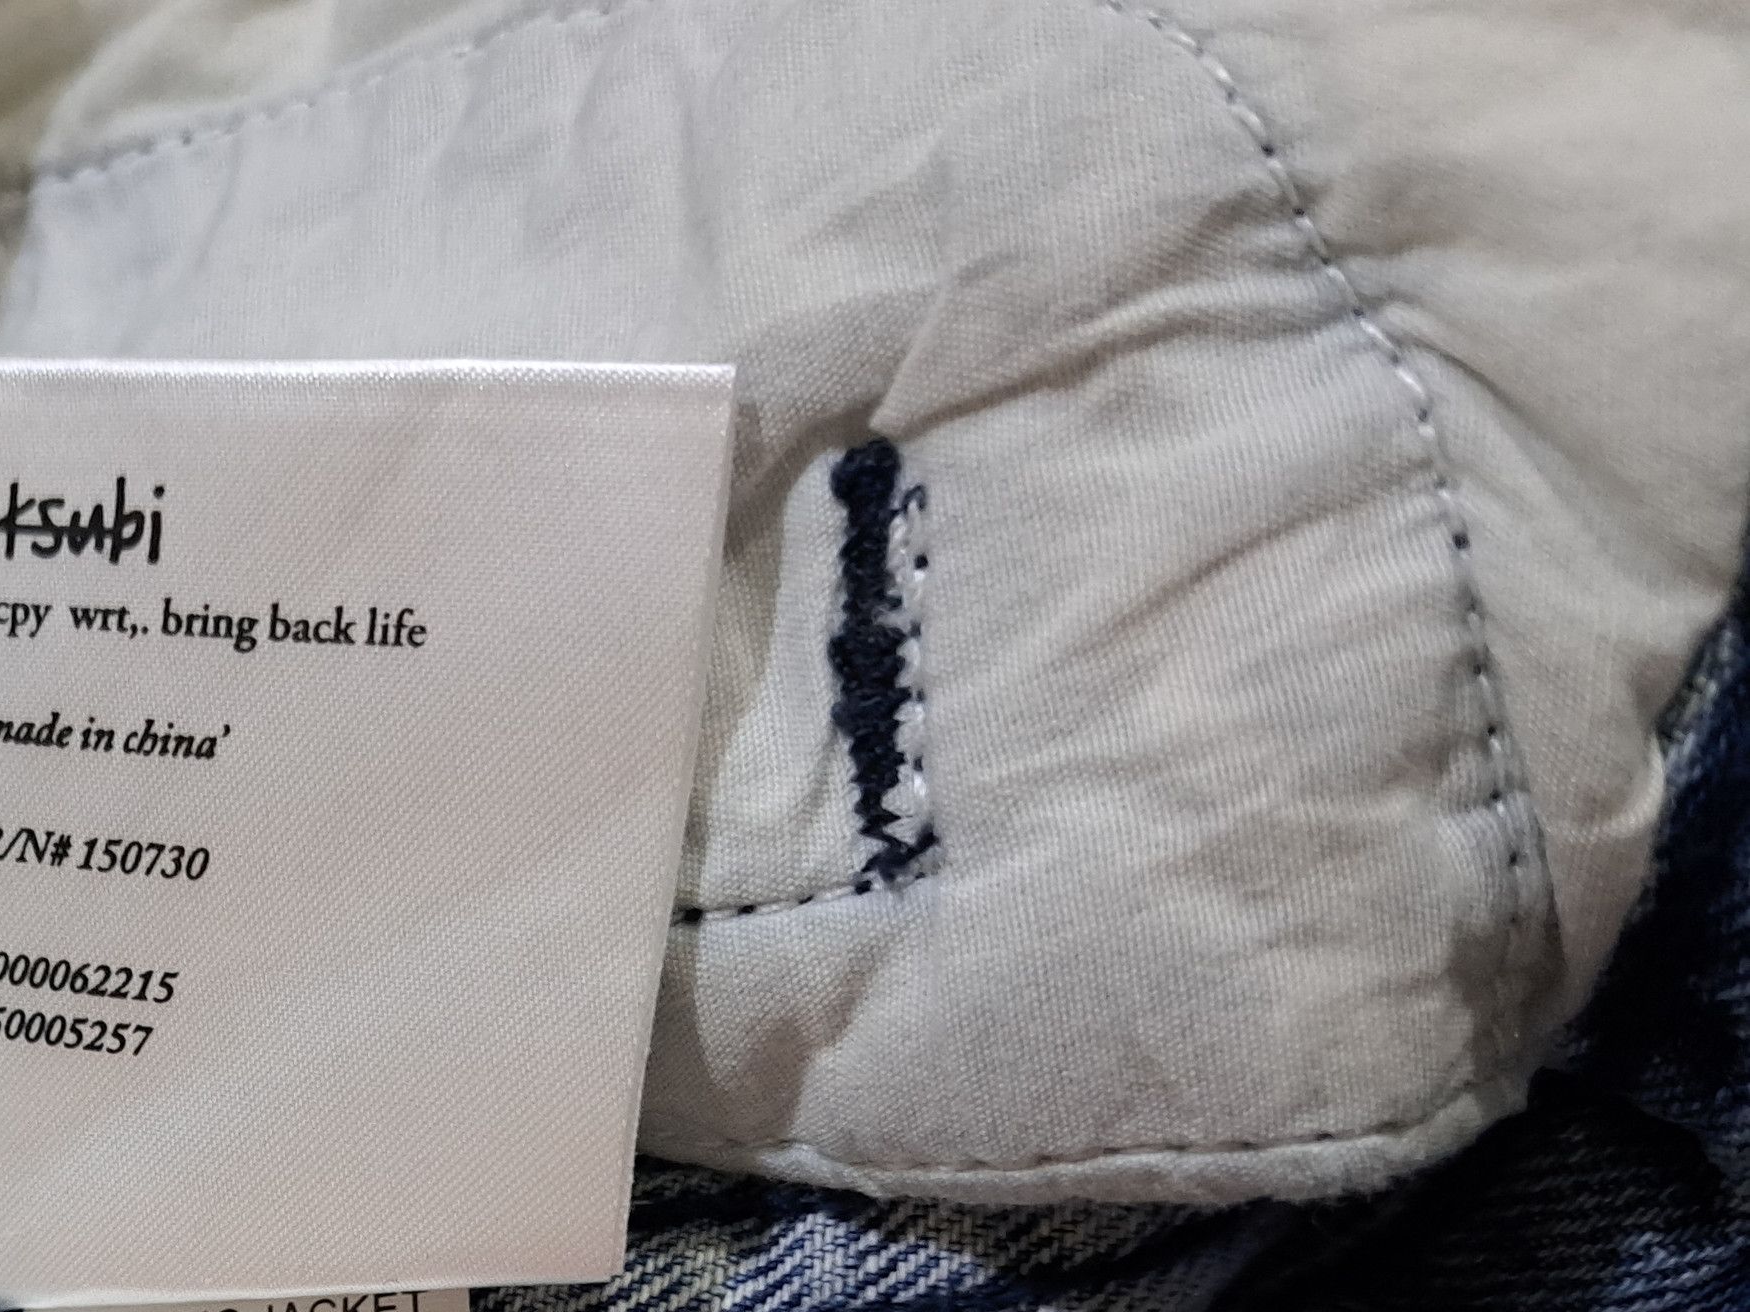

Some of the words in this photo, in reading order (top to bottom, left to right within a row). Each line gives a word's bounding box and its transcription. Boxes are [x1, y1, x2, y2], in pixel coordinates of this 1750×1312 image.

[160, 596, 260, 655] bring
[267, 601, 357, 647] back
[364, 606, 428, 649] life
[79, 715, 116, 753] in
[76, 837, 211, 882] 150730
